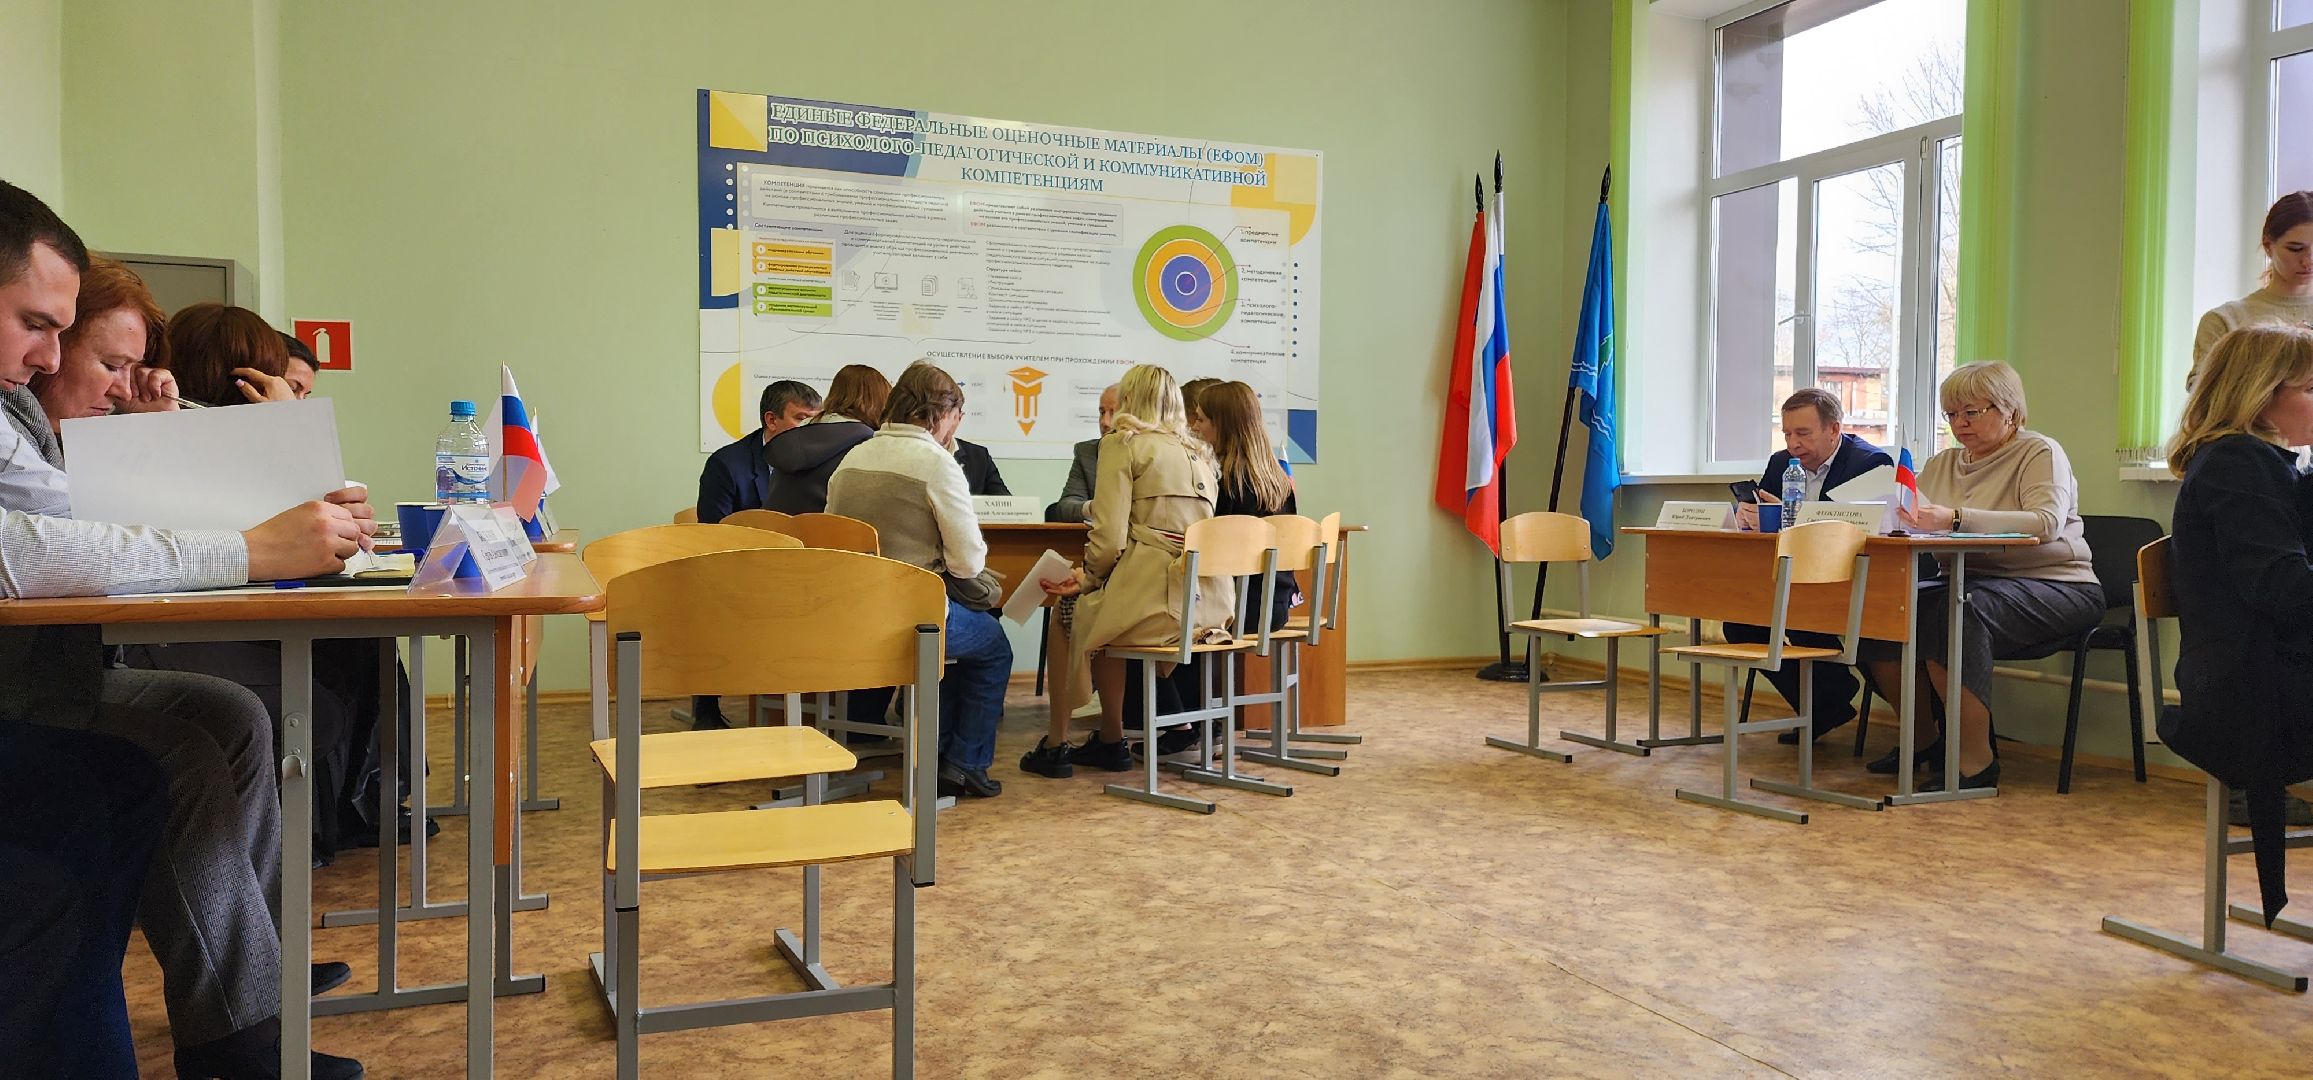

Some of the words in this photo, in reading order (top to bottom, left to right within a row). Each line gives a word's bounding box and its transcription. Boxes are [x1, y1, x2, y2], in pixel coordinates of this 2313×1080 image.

[772, 104, 853, 126] ЕДИНЫЕ
[857, 111, 988, 139] ФЕДЕРАЛЬНЫЕ
[992, 127, 1099, 150] ОЦЕНОЧНЫЕ
[1104, 138, 1203, 161] МАТЕРИАЛЫ
[1206, 148, 1264, 168] (ЕФОМ)
[769, 127, 798, 143] ПО
[801, 129, 1079, 171] ПСИХОЛОГО-ПЕДАГОГИЧЕСКОЙ
[1084, 159, 1095, 172] И
[1100, 159, 1267, 187] КОММУНИКАТИВНОЙ
[763, 180, 805, 188] КОМПЕТЕНЦИЯ
[961, 167, 1104, 192] КОМПЕТЕНЦИЯМ
[926, 351, 986, 360] ОСУЩЕСТВЛЕНИЕ
[987, 353, 1014, 361] ВЫБОРА
[1015, 354, 1049, 362] УЧИТЕЛЕМ
[1065, 356, 1115, 365] ПРОХОЖДЕНИИ
